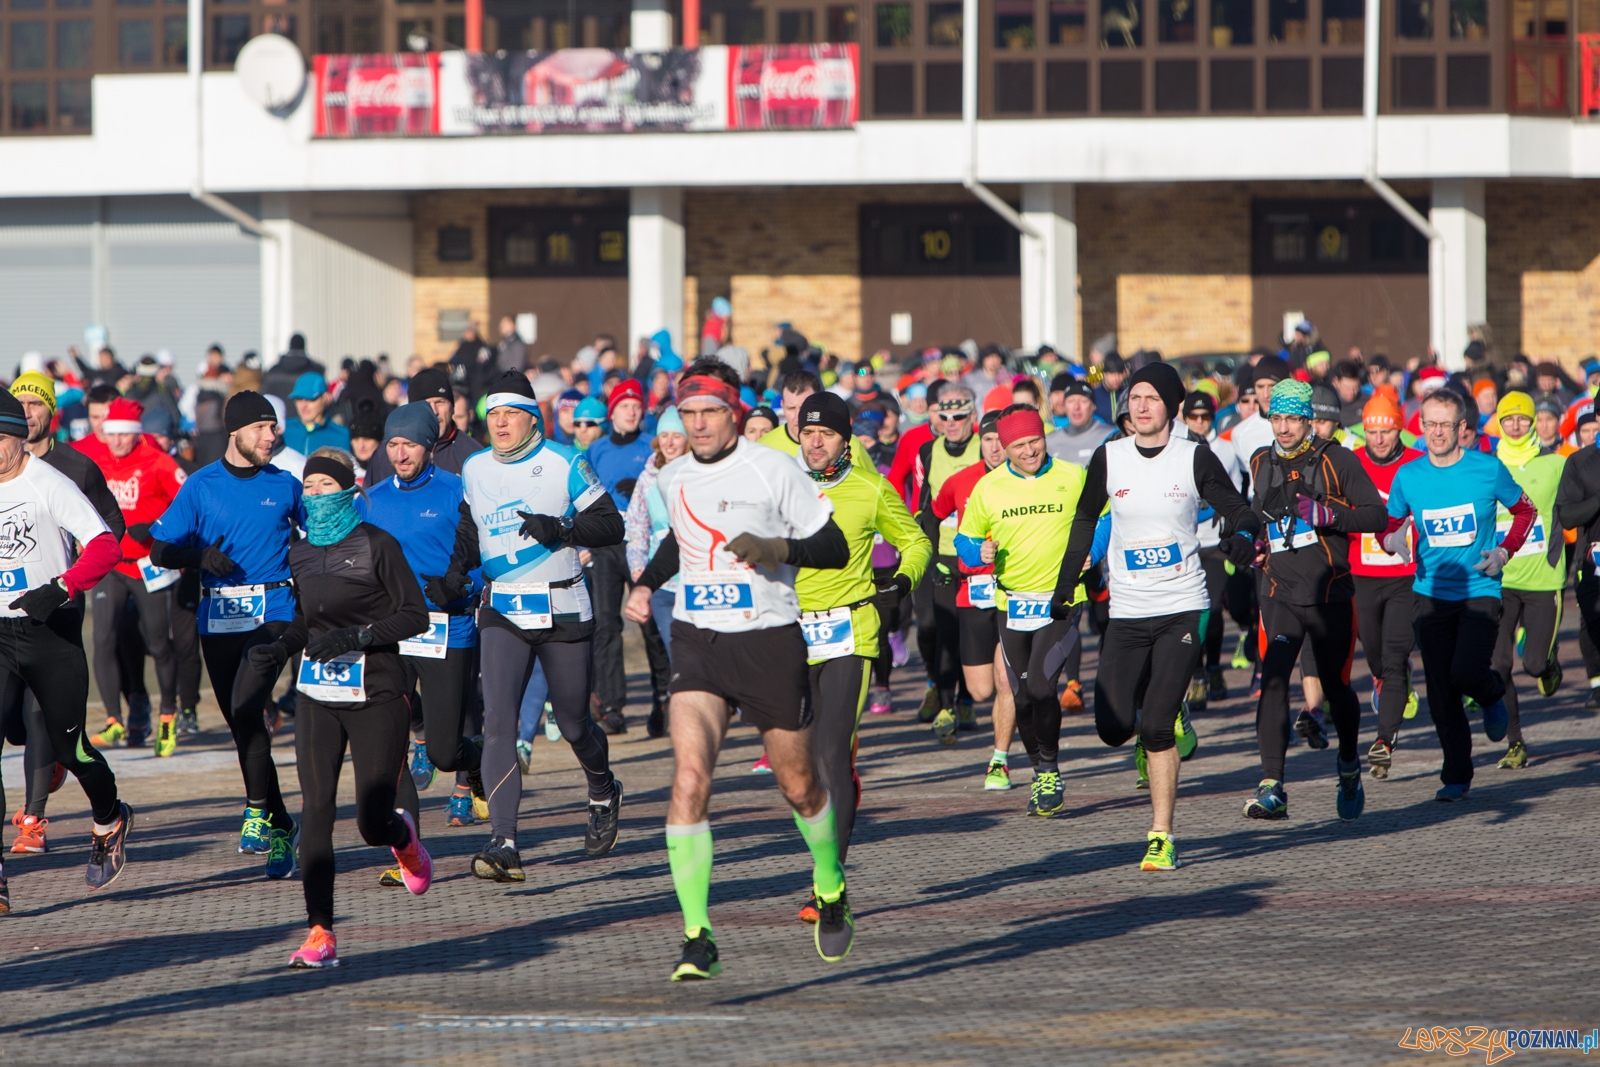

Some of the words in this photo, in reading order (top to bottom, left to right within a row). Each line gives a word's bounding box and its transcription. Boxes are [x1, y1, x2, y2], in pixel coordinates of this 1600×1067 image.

[921, 229, 951, 260] 10
[1322, 225, 1341, 256] 9
[1001, 503, 1063, 519] ANDRZEJ
[1432, 515, 1465, 533] 217
[1133, 547, 1171, 566] 399
[511, 594, 523, 611] 1
[692, 584, 741, 606] 239
[216, 597, 254, 615] 135
[1016, 600, 1049, 616] 277
[803, 622, 833, 642] 16
[310, 661, 351, 682] 163
